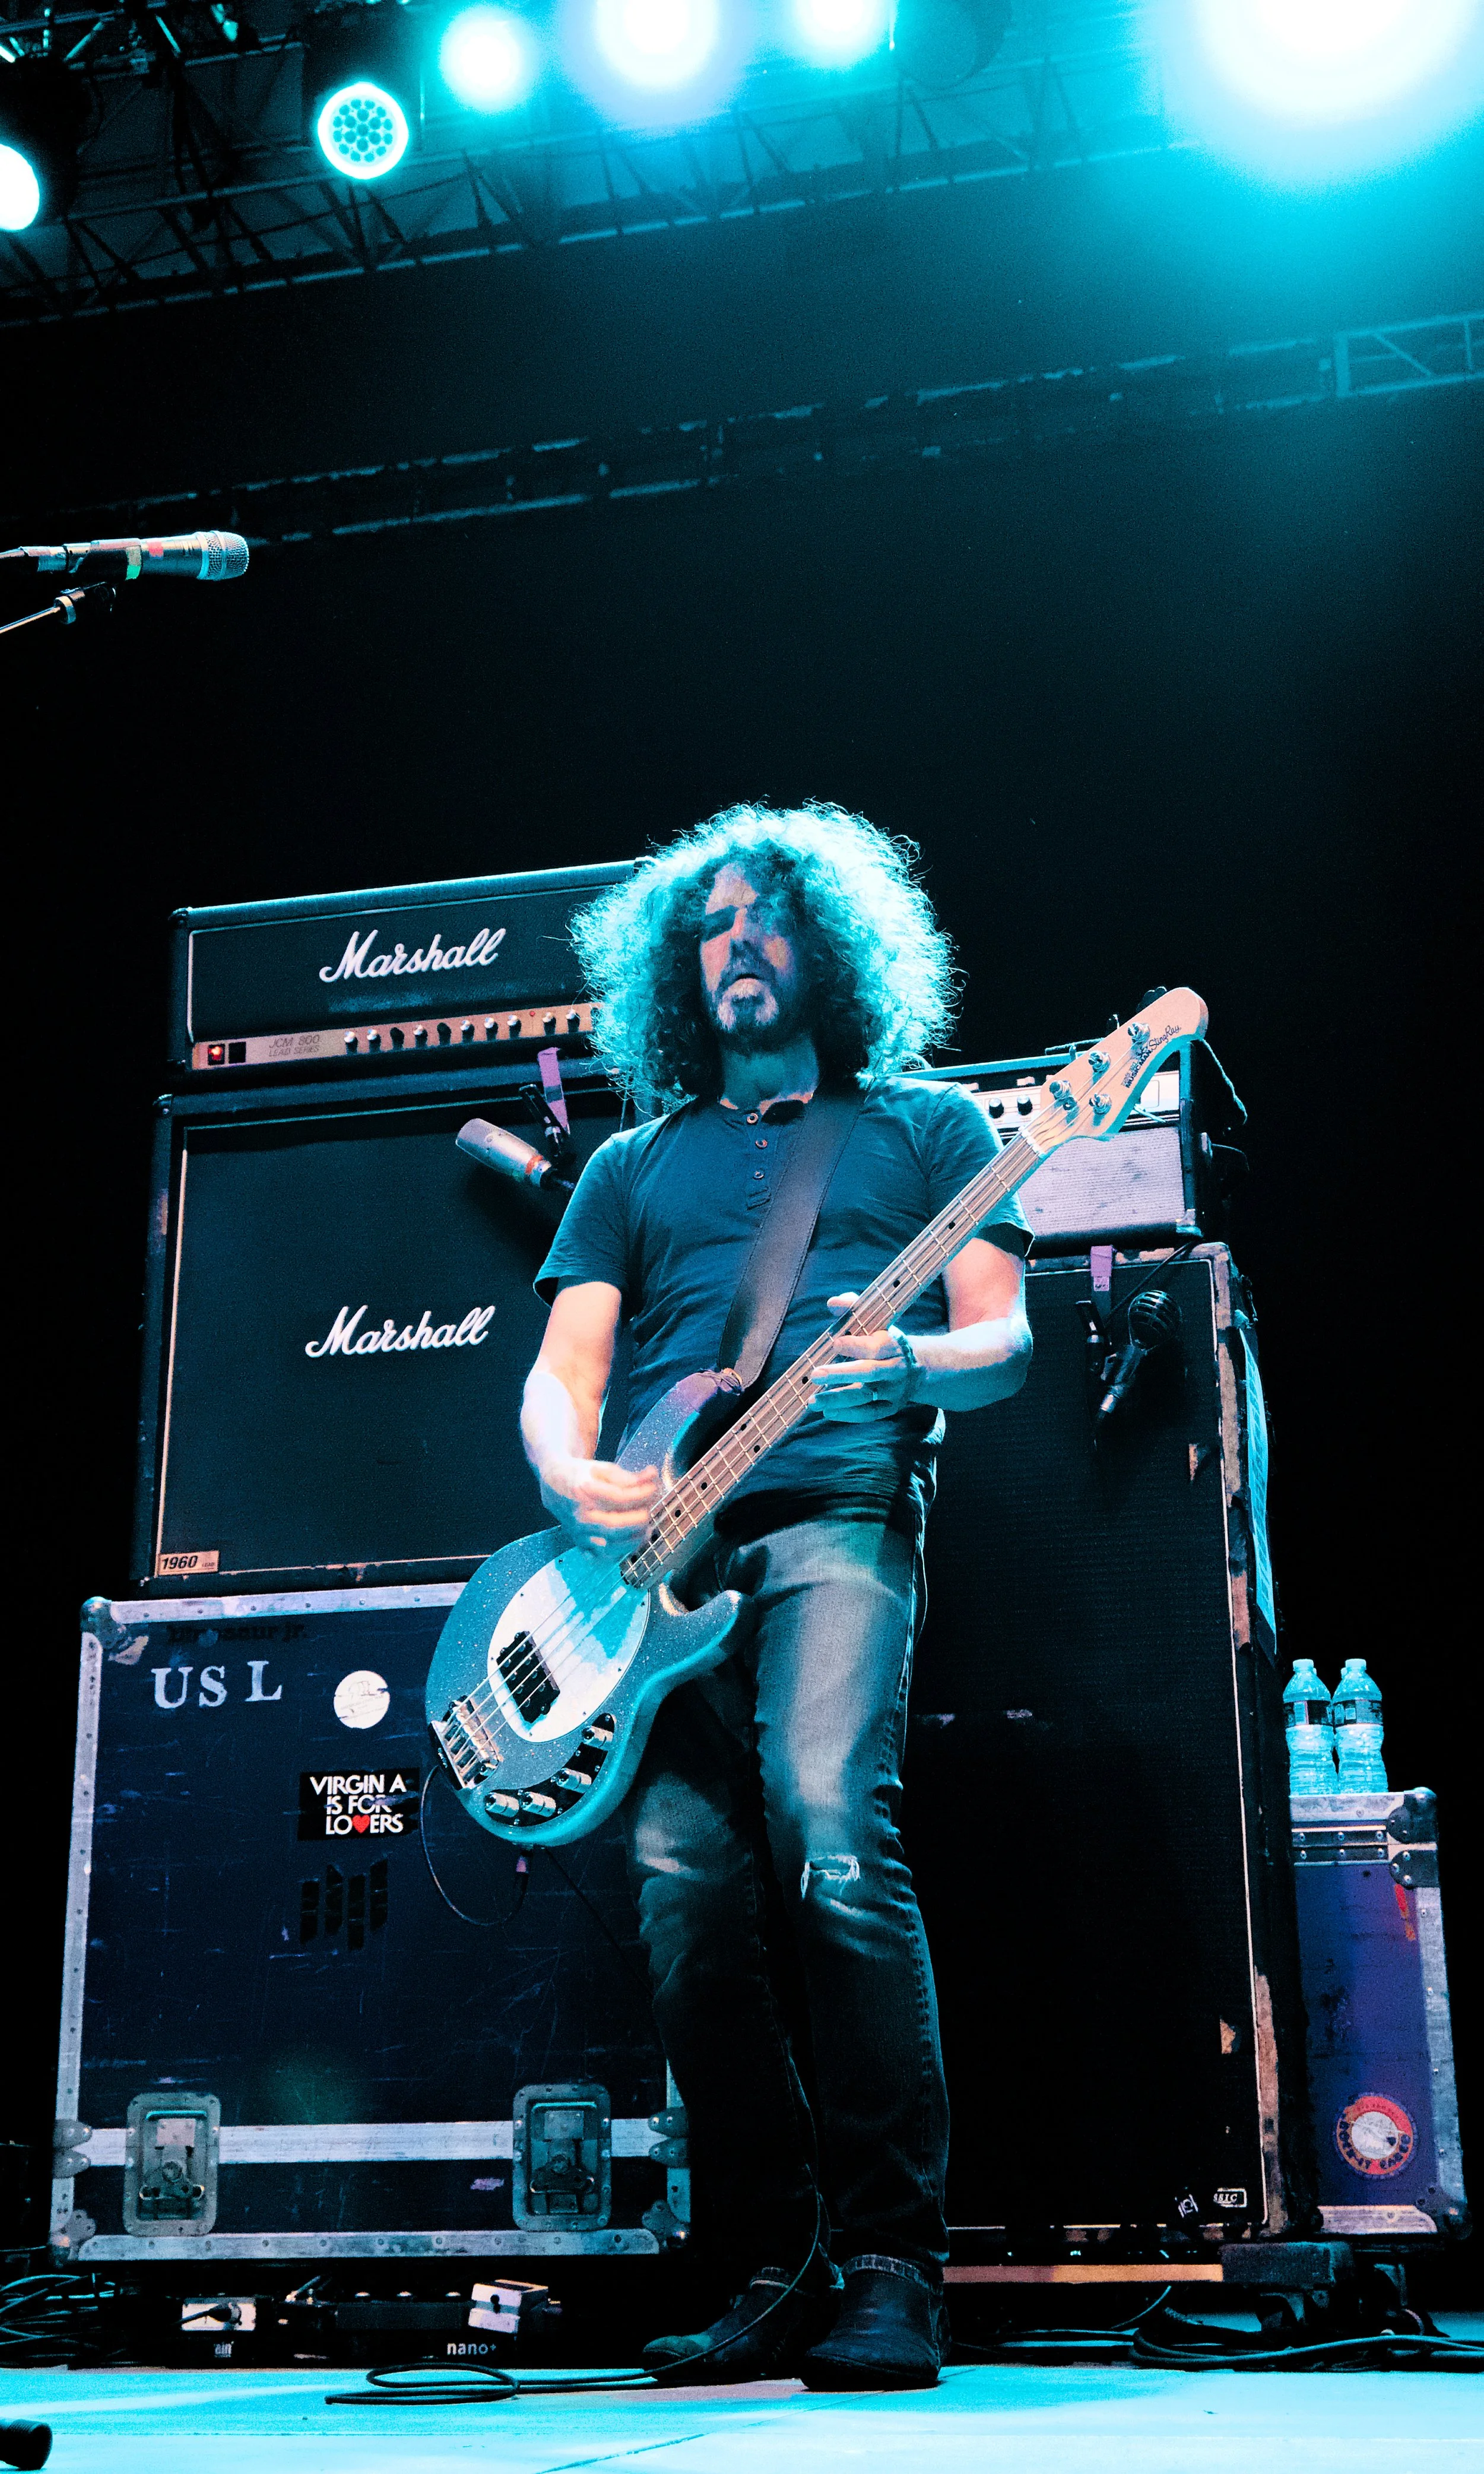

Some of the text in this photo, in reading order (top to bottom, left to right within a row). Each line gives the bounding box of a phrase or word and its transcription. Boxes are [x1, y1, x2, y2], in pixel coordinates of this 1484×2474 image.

[319, 929, 506, 983] Marshall
[269, 1034, 320, 1048] JCM 800
[268, 1045, 320, 1057] LEAD SERIES
[305, 1305, 496, 1358] Marshall
[162, 1555, 198, 1570] 1960
[326, 1794, 392, 1815] IS FOR
